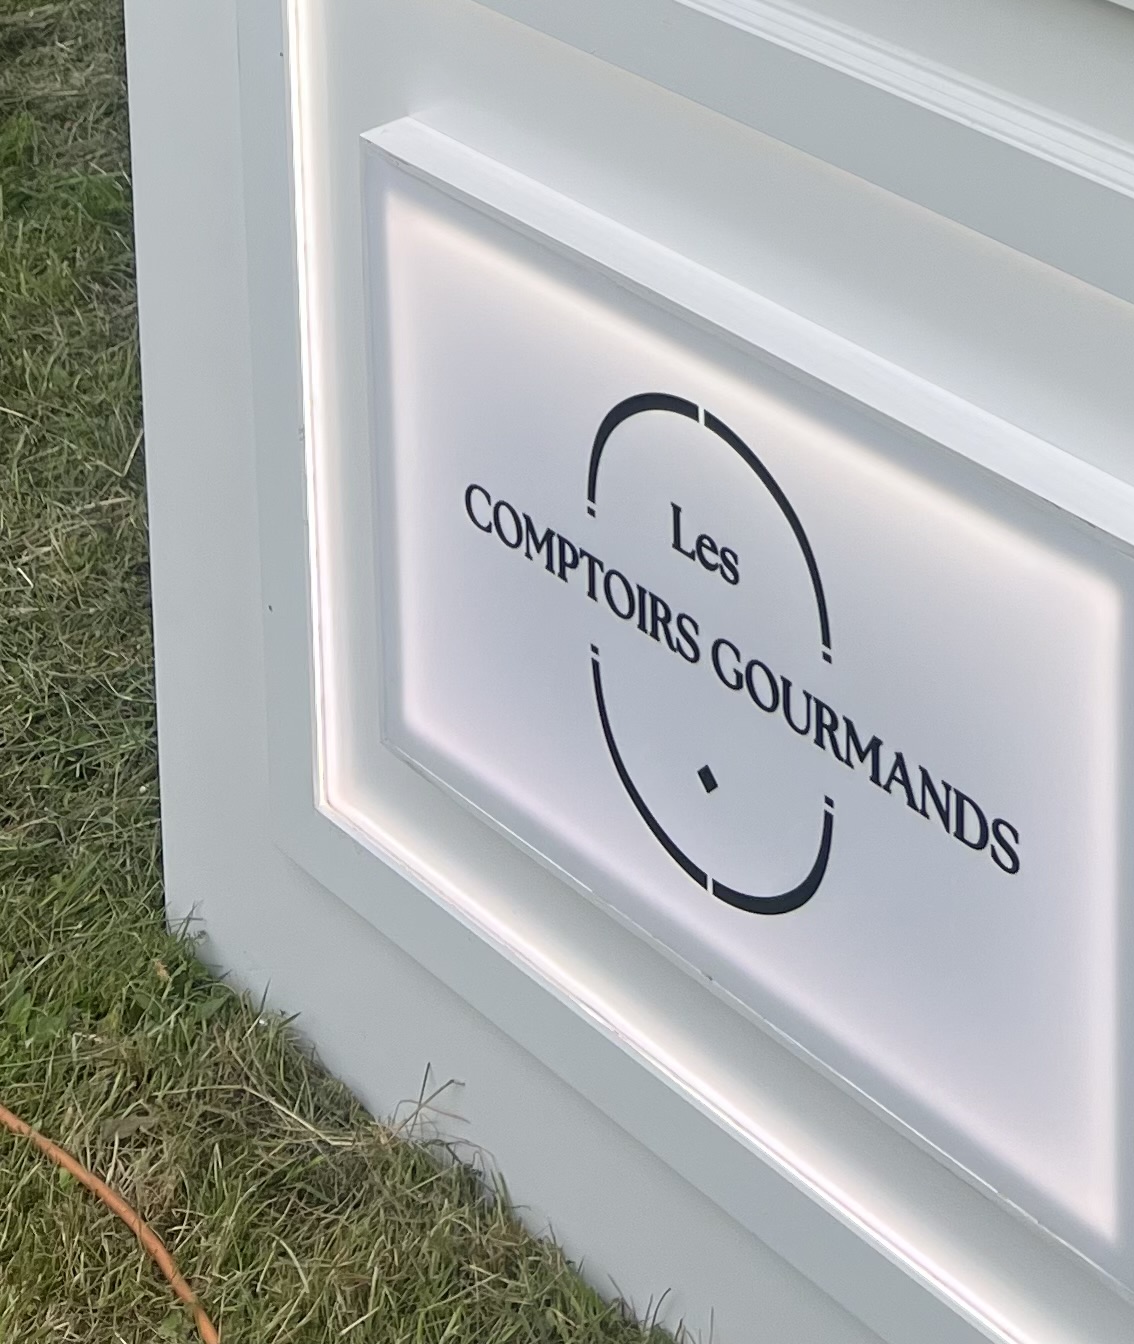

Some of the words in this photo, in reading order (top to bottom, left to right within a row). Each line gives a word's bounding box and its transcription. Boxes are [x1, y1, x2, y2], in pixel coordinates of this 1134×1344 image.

[670, 502, 740, 585] Les
[464, 483, 701, 664] COMPTOIRS
[711, 638, 1020, 875] GOURMANDS
